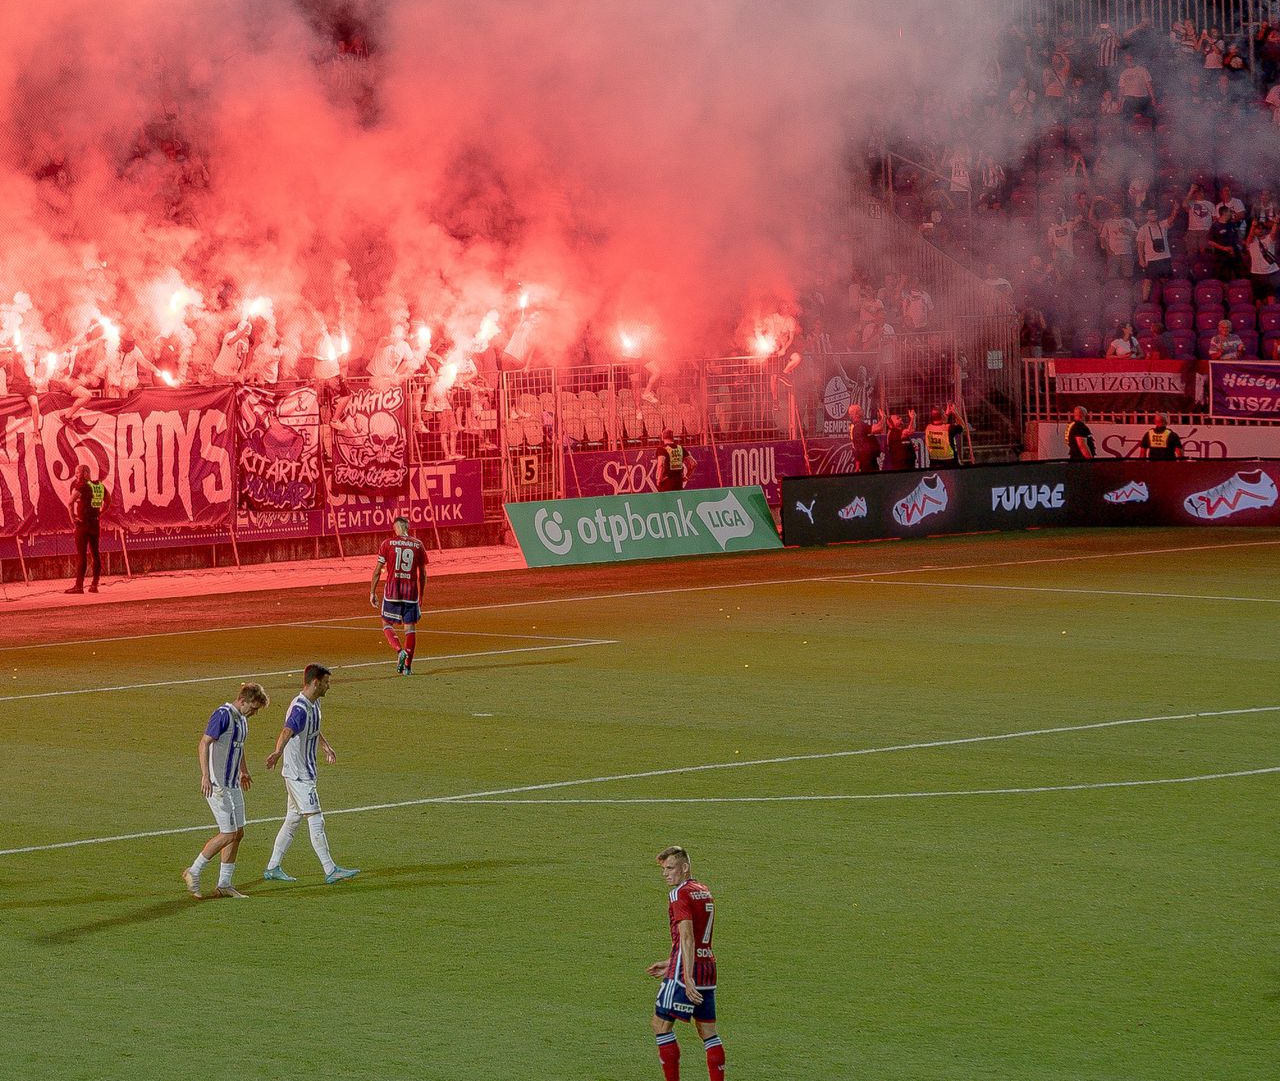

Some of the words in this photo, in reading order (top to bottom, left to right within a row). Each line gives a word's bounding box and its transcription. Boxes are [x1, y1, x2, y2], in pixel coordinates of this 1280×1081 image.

[1060, 372, 1181, 392] HÉVÍZGYÖRK
[824, 420, 852, 434] SEMPE
[117, 408, 232, 521] BOYS
[240, 446, 319, 483] KITARTÁS
[524, 459, 536, 481] 5
[992, 483, 1066, 511] FUTURE
[577, 499, 699, 553] otpbank
[707, 509, 745, 528] LIGA
[395, 547, 414, 572] 19
[702, 903, 714, 944] 7
